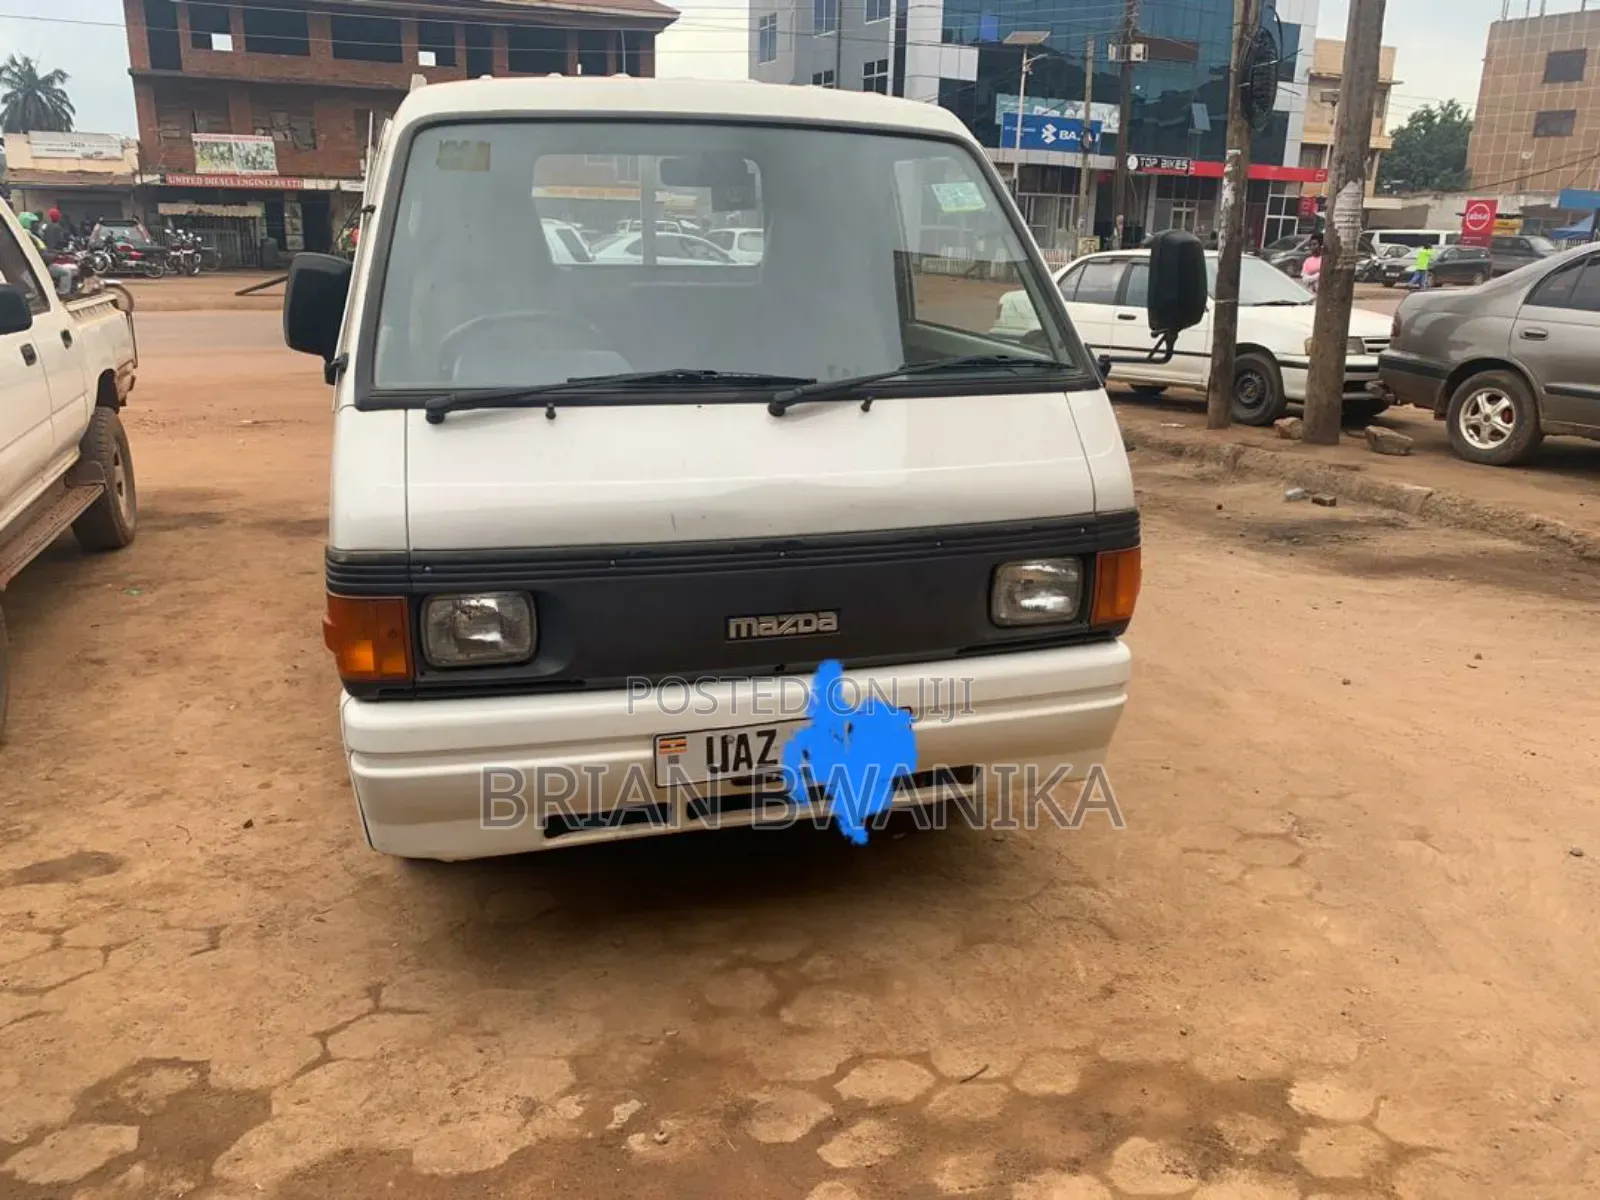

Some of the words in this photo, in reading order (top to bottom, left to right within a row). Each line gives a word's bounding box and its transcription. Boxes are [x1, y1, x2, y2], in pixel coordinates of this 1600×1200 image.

[1059, 129, 1100, 142] BAJ
[1140, 157, 1158, 167] TOP
[1161, 159, 1188, 170] BIKES
[168, 175, 203, 185] UNITED
[729, 611, 838, 639] mazda
[706, 729, 778, 774] UAZ
